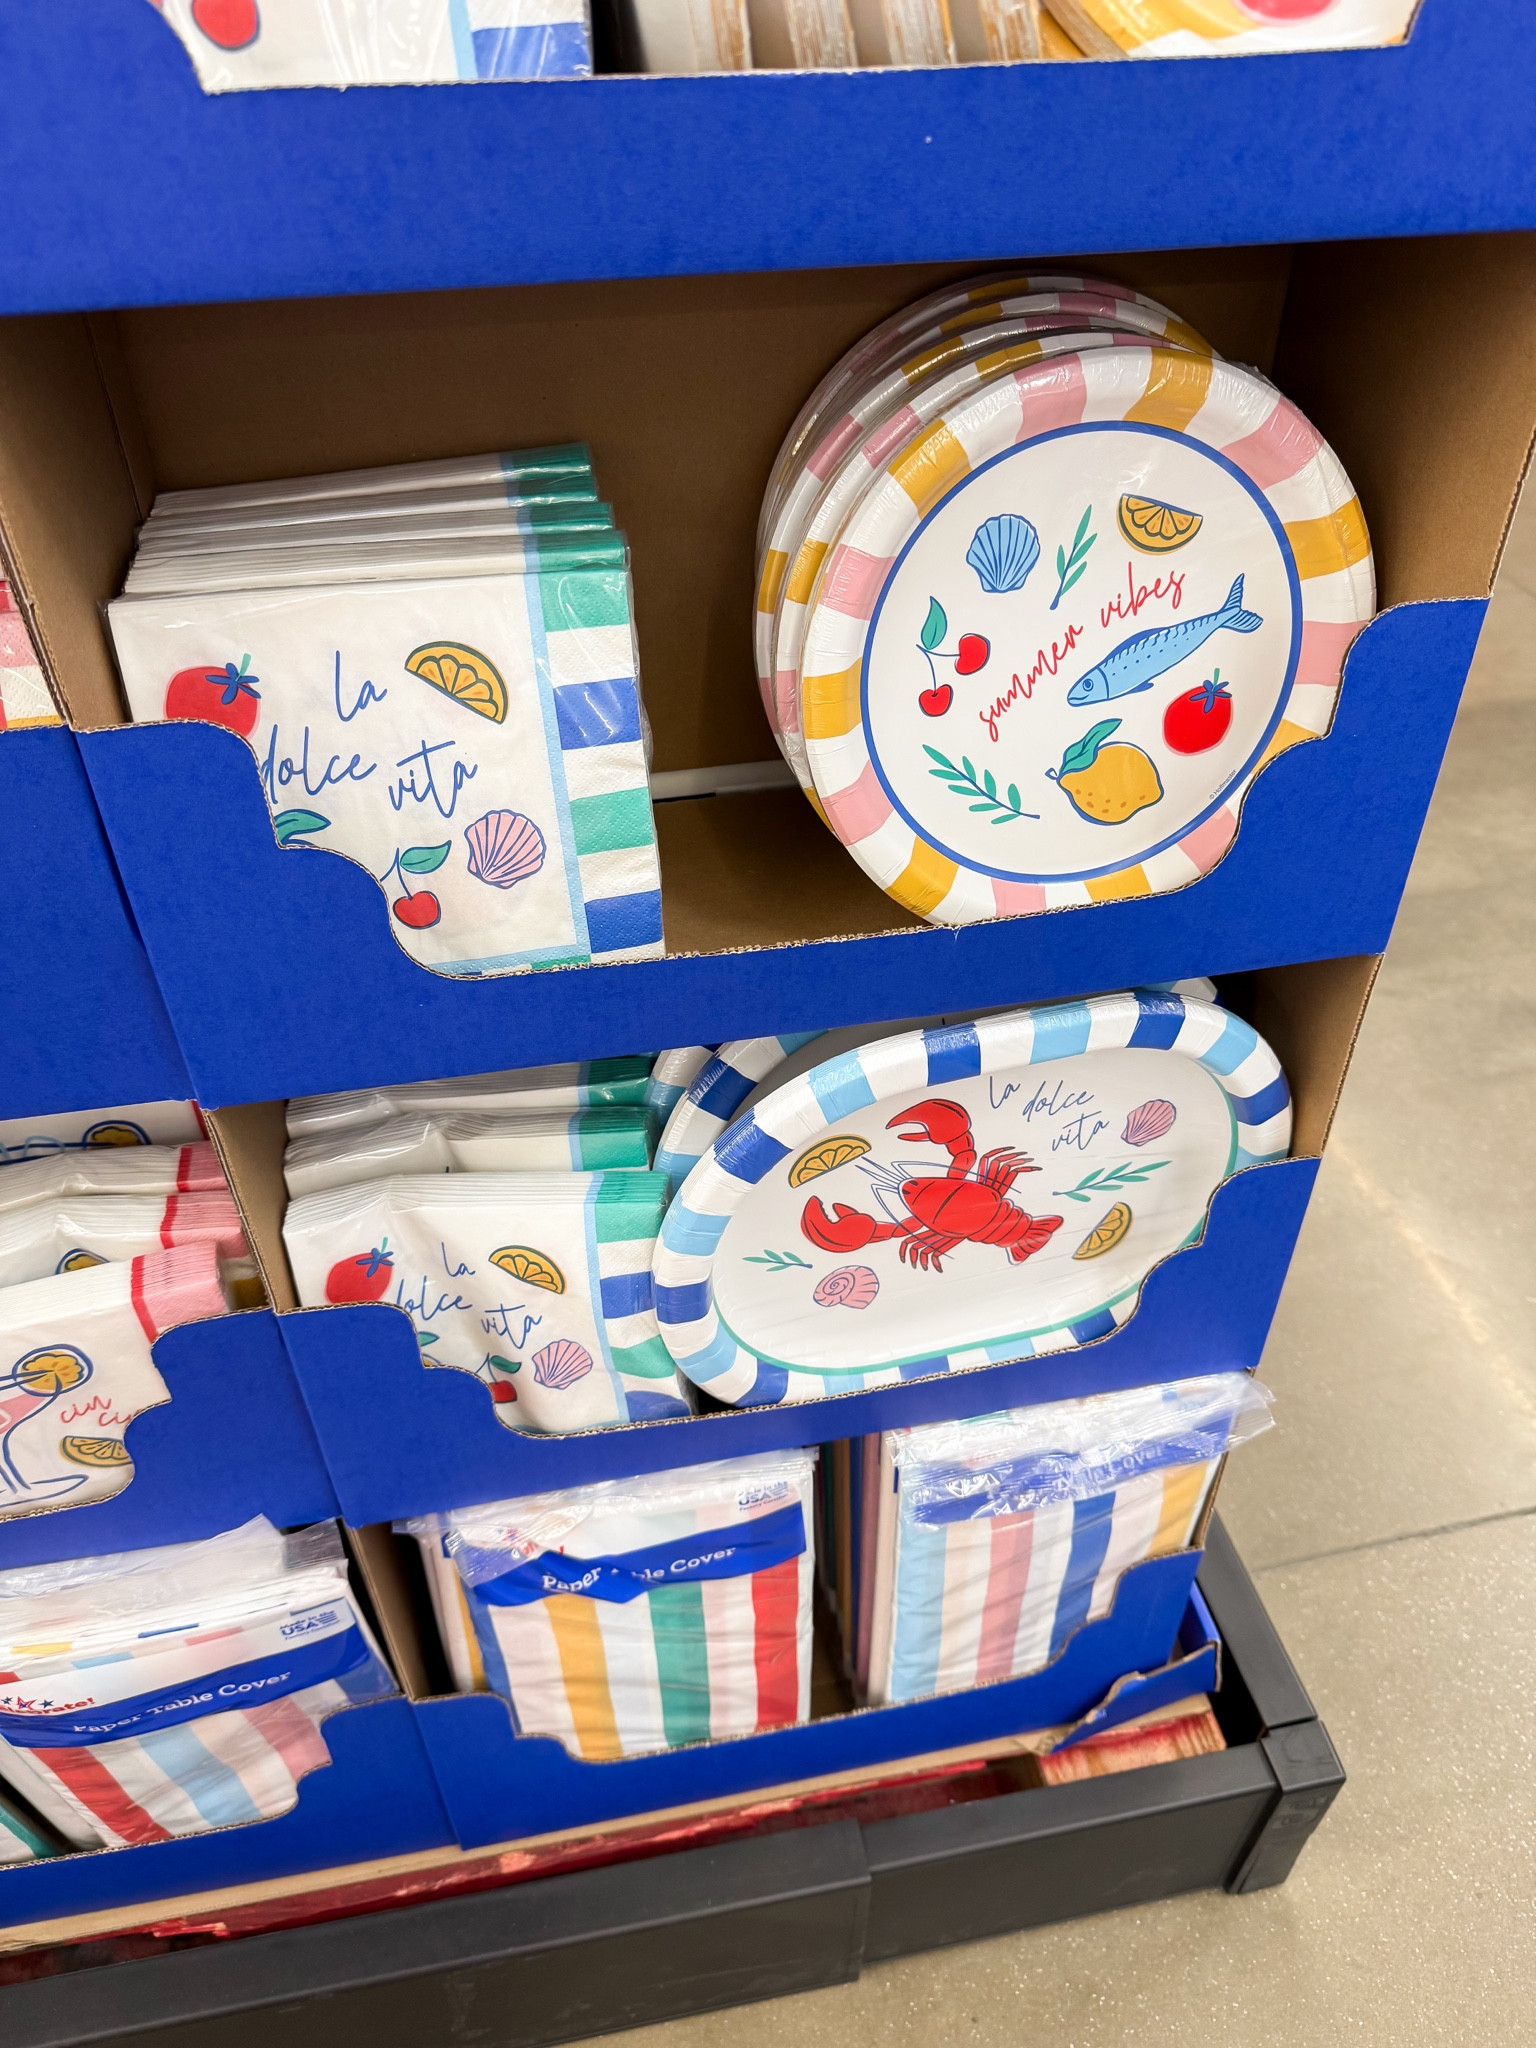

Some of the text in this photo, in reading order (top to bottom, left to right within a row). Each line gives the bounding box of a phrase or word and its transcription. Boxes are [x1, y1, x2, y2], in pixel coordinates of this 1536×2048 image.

[979, 561, 1186, 743] summer vibes
[335, 650, 388, 722] la
[261, 724, 478, 818] dolce vita
[989, 1075, 1095, 1123] la dolce
[1051, 1110, 1110, 1152] vita
[441, 1241, 477, 1278] la
[480, 1303, 543, 1350] vita
[98, 1408, 142, 1428] ci
[738, 1491, 773, 1507] USA
[669, 1547, 737, 1573] Cover
[281, 1620, 320, 1637] USA
[146, 1693, 214, 1716] Table
[217, 1672, 292, 1697] Cover
